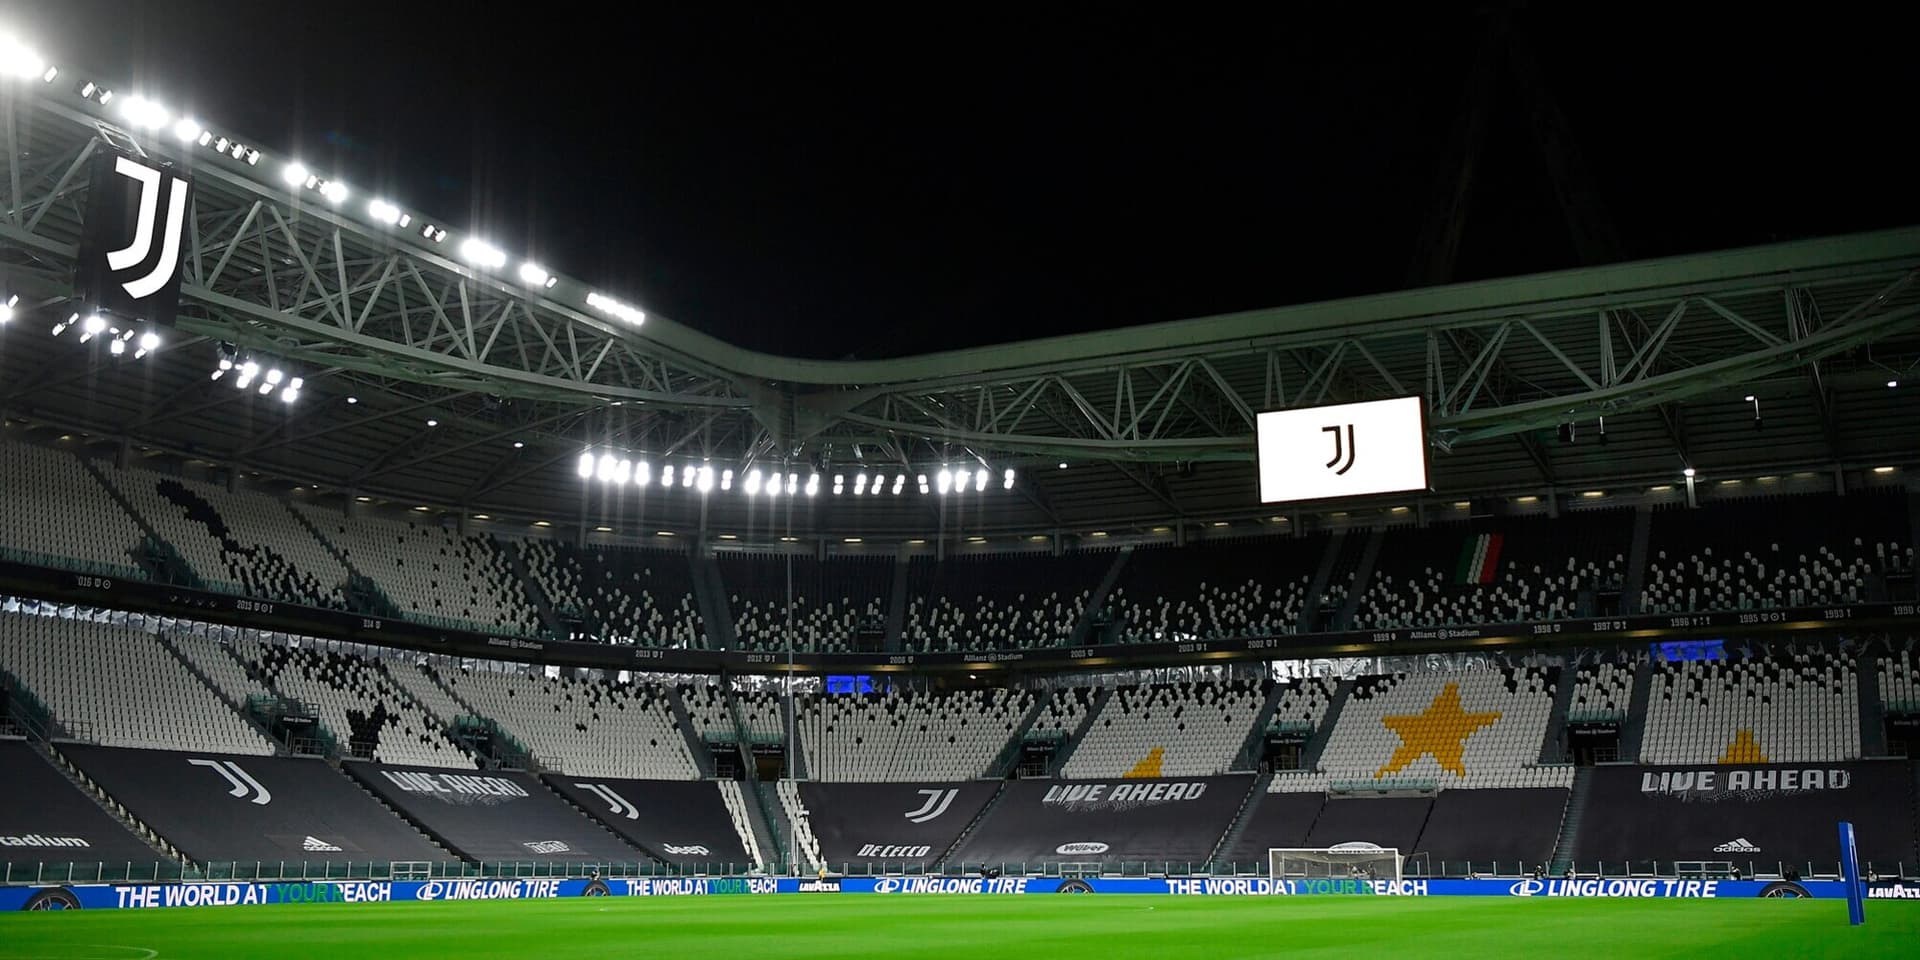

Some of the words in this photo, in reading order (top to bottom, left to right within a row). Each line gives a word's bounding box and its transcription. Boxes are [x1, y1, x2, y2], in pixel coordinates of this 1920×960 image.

[76, 575, 92, 588] 016
[1739, 613, 1759, 624] 1995
[1823, 608, 1844, 619] 1993
[1893, 605, 1914, 616] 1990
[1592, 621, 1611, 631] 1997
[1670, 617, 1690, 627] 1996
[1410, 631, 1437, 639] Allianz
[1448, 629, 1480, 638] Stadium
[438, 773, 530, 796] AHEAD
[1641, 771, 1716, 793] LIVE
[1727, 770, 1851, 791] AHEAD
[1041, 784, 1107, 803] LIVE
[1107, 783, 1207, 802] AHEAD
[1713, 845, 1761, 853] adidas
[115, 886, 159, 908] THE
[164, 884, 242, 907] WORLD
[276, 882, 330, 904] YOUR
[444, 879, 521, 901] LINGLONG
[523, 879, 560, 898] TIRE
[626, 879, 653, 896] THE
[652, 878, 693, 896] WORLD
[712, 878, 743, 897] YOUR
[901, 878, 983, 895] LINGLONG
[984, 878, 1028, 895] TIRE
[1165, 879, 1202, 896] THE
[1204, 878, 1274, 896] WORLD
[1304, 879, 1362, 896] YOUR
[1548, 880, 1663, 898] LINGLONG
[1664, 880, 1719, 898] TIRE
